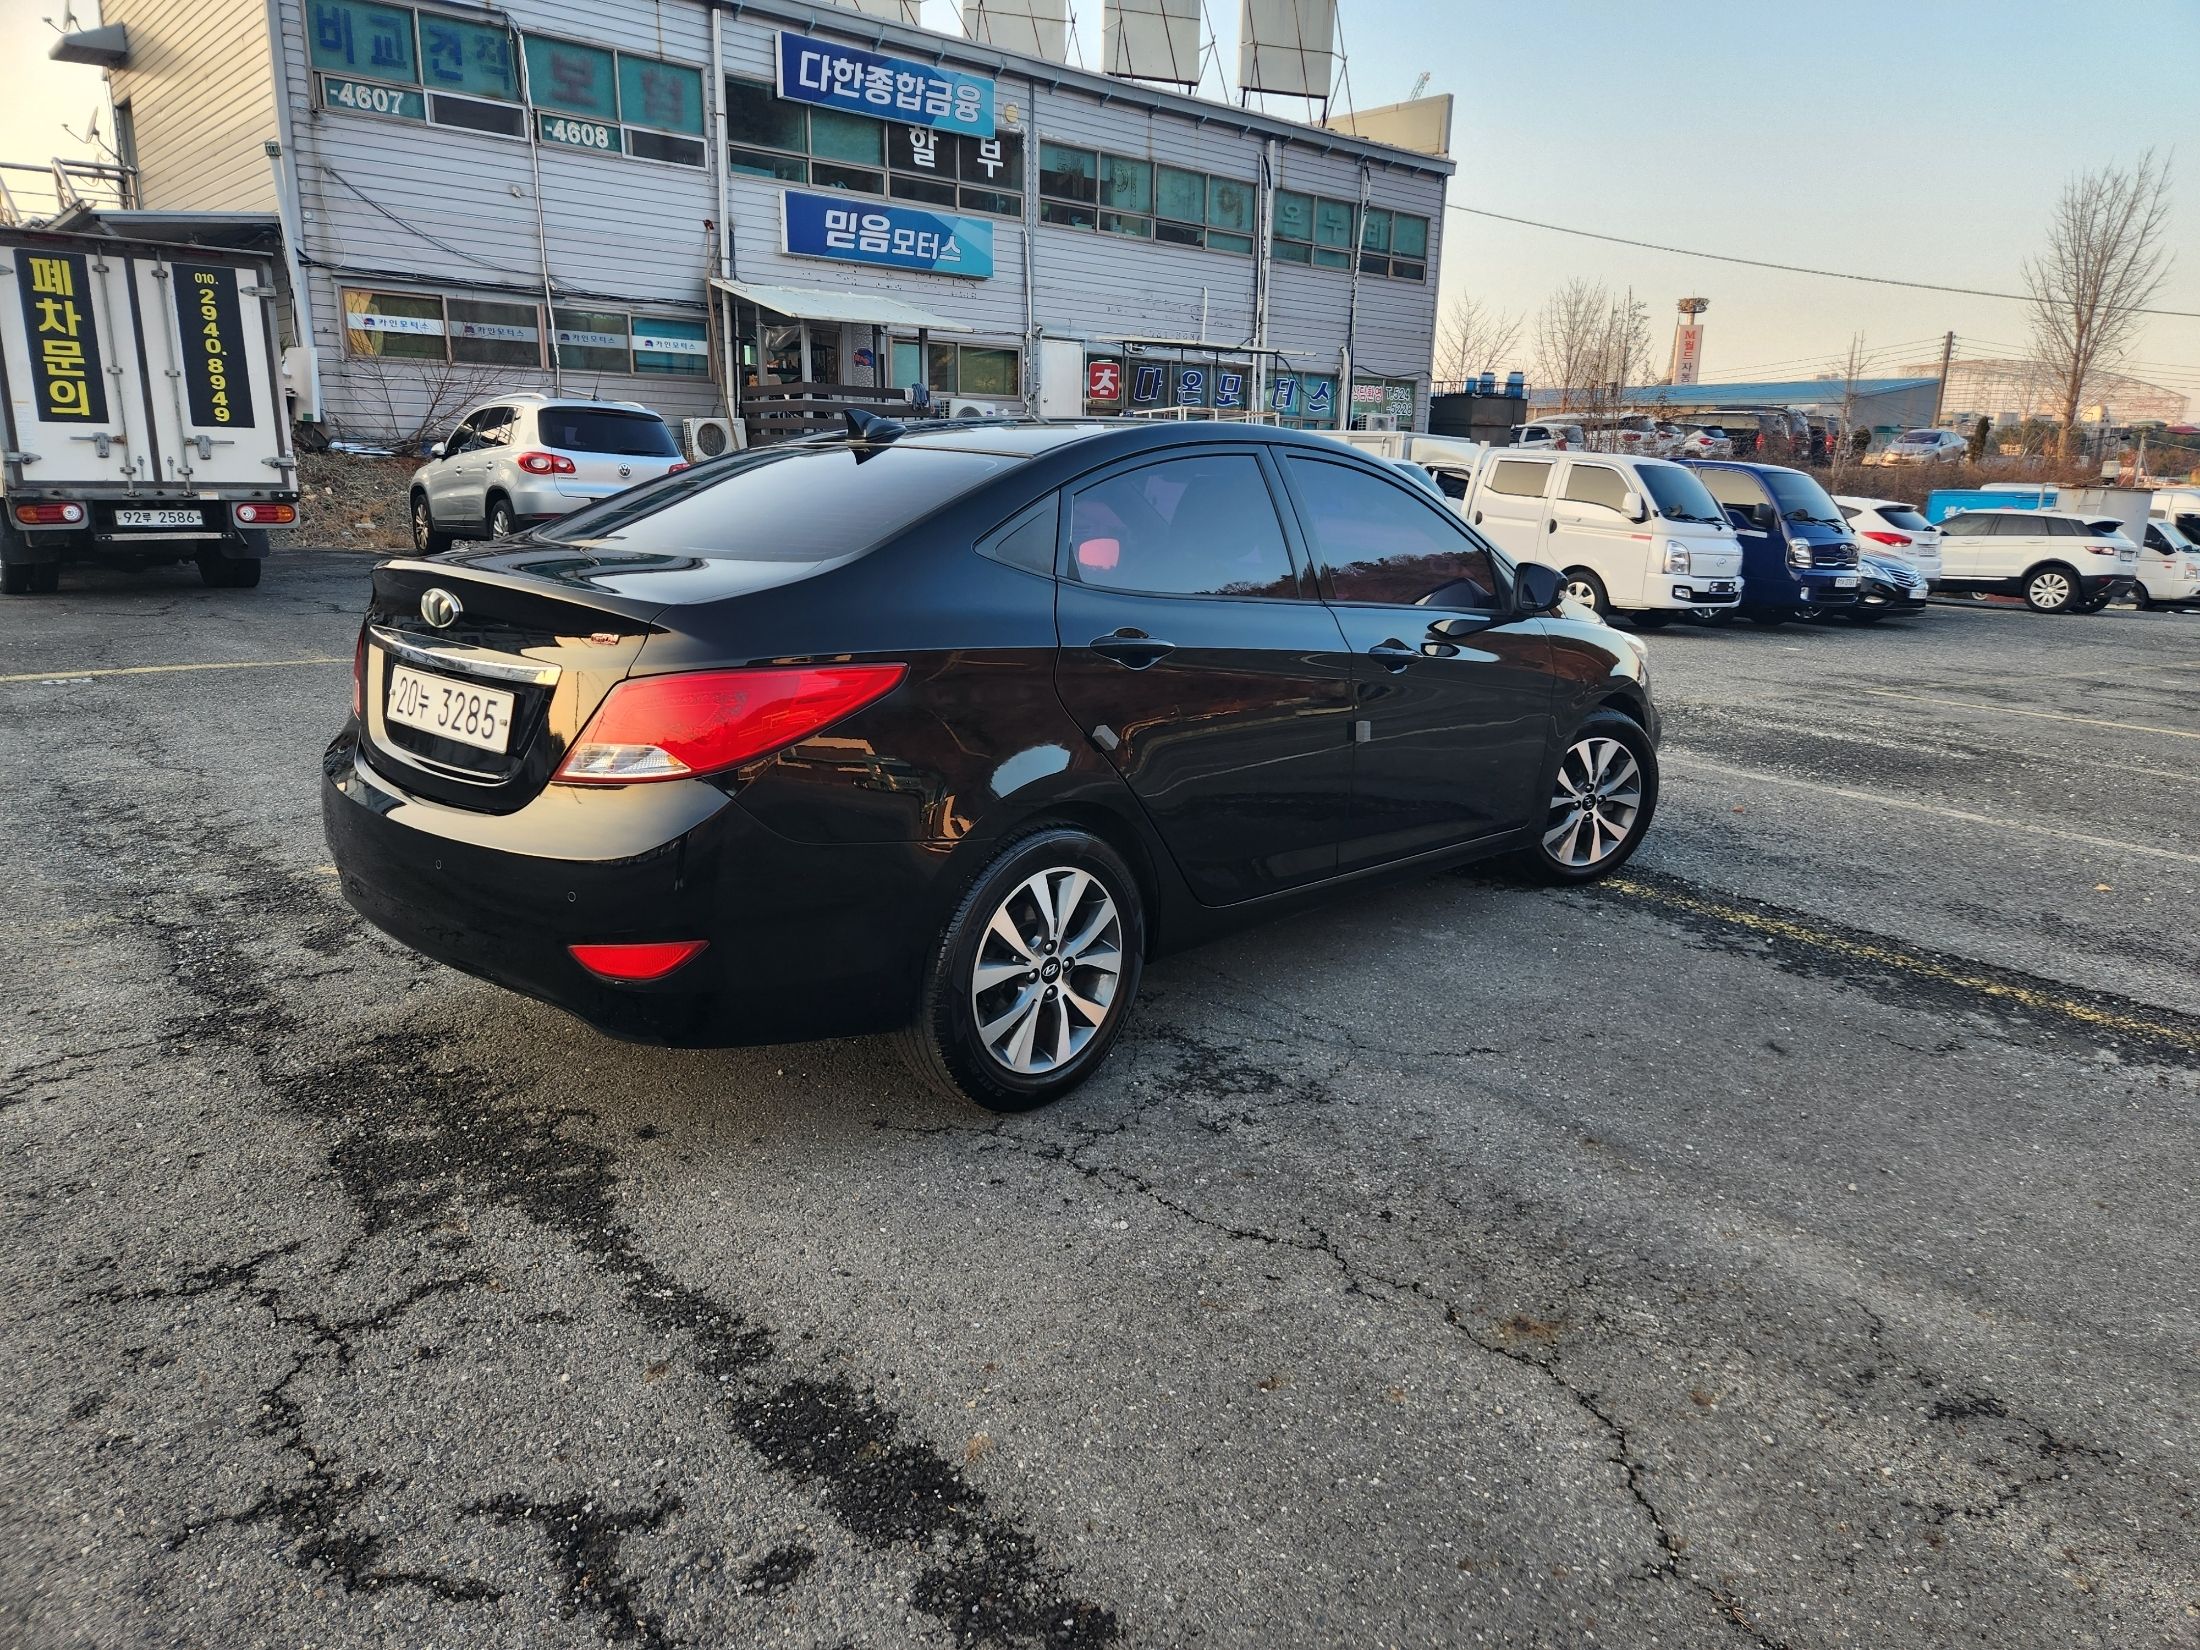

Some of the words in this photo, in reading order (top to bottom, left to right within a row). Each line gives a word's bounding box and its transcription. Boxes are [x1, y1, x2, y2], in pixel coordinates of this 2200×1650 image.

[799, 50, 982, 123] 다한종합금융
[824, 209, 962, 262] 믿음모터스
[194, 272, 219, 285] 010.
[29, 257, 90, 416] 폐차문의
[378, 318, 430, 331] 카인모터스
[572, 334, 616, 345] 카인모터스
[655, 341, 697, 351] 카인모터스
[1133, 366, 1331, 412] 다온모터스
[123, 511, 152, 524] 92루
[158, 511, 195, 524] 2586
[396, 676, 430, 719] 20누
[437, 688, 499, 740] 3285
